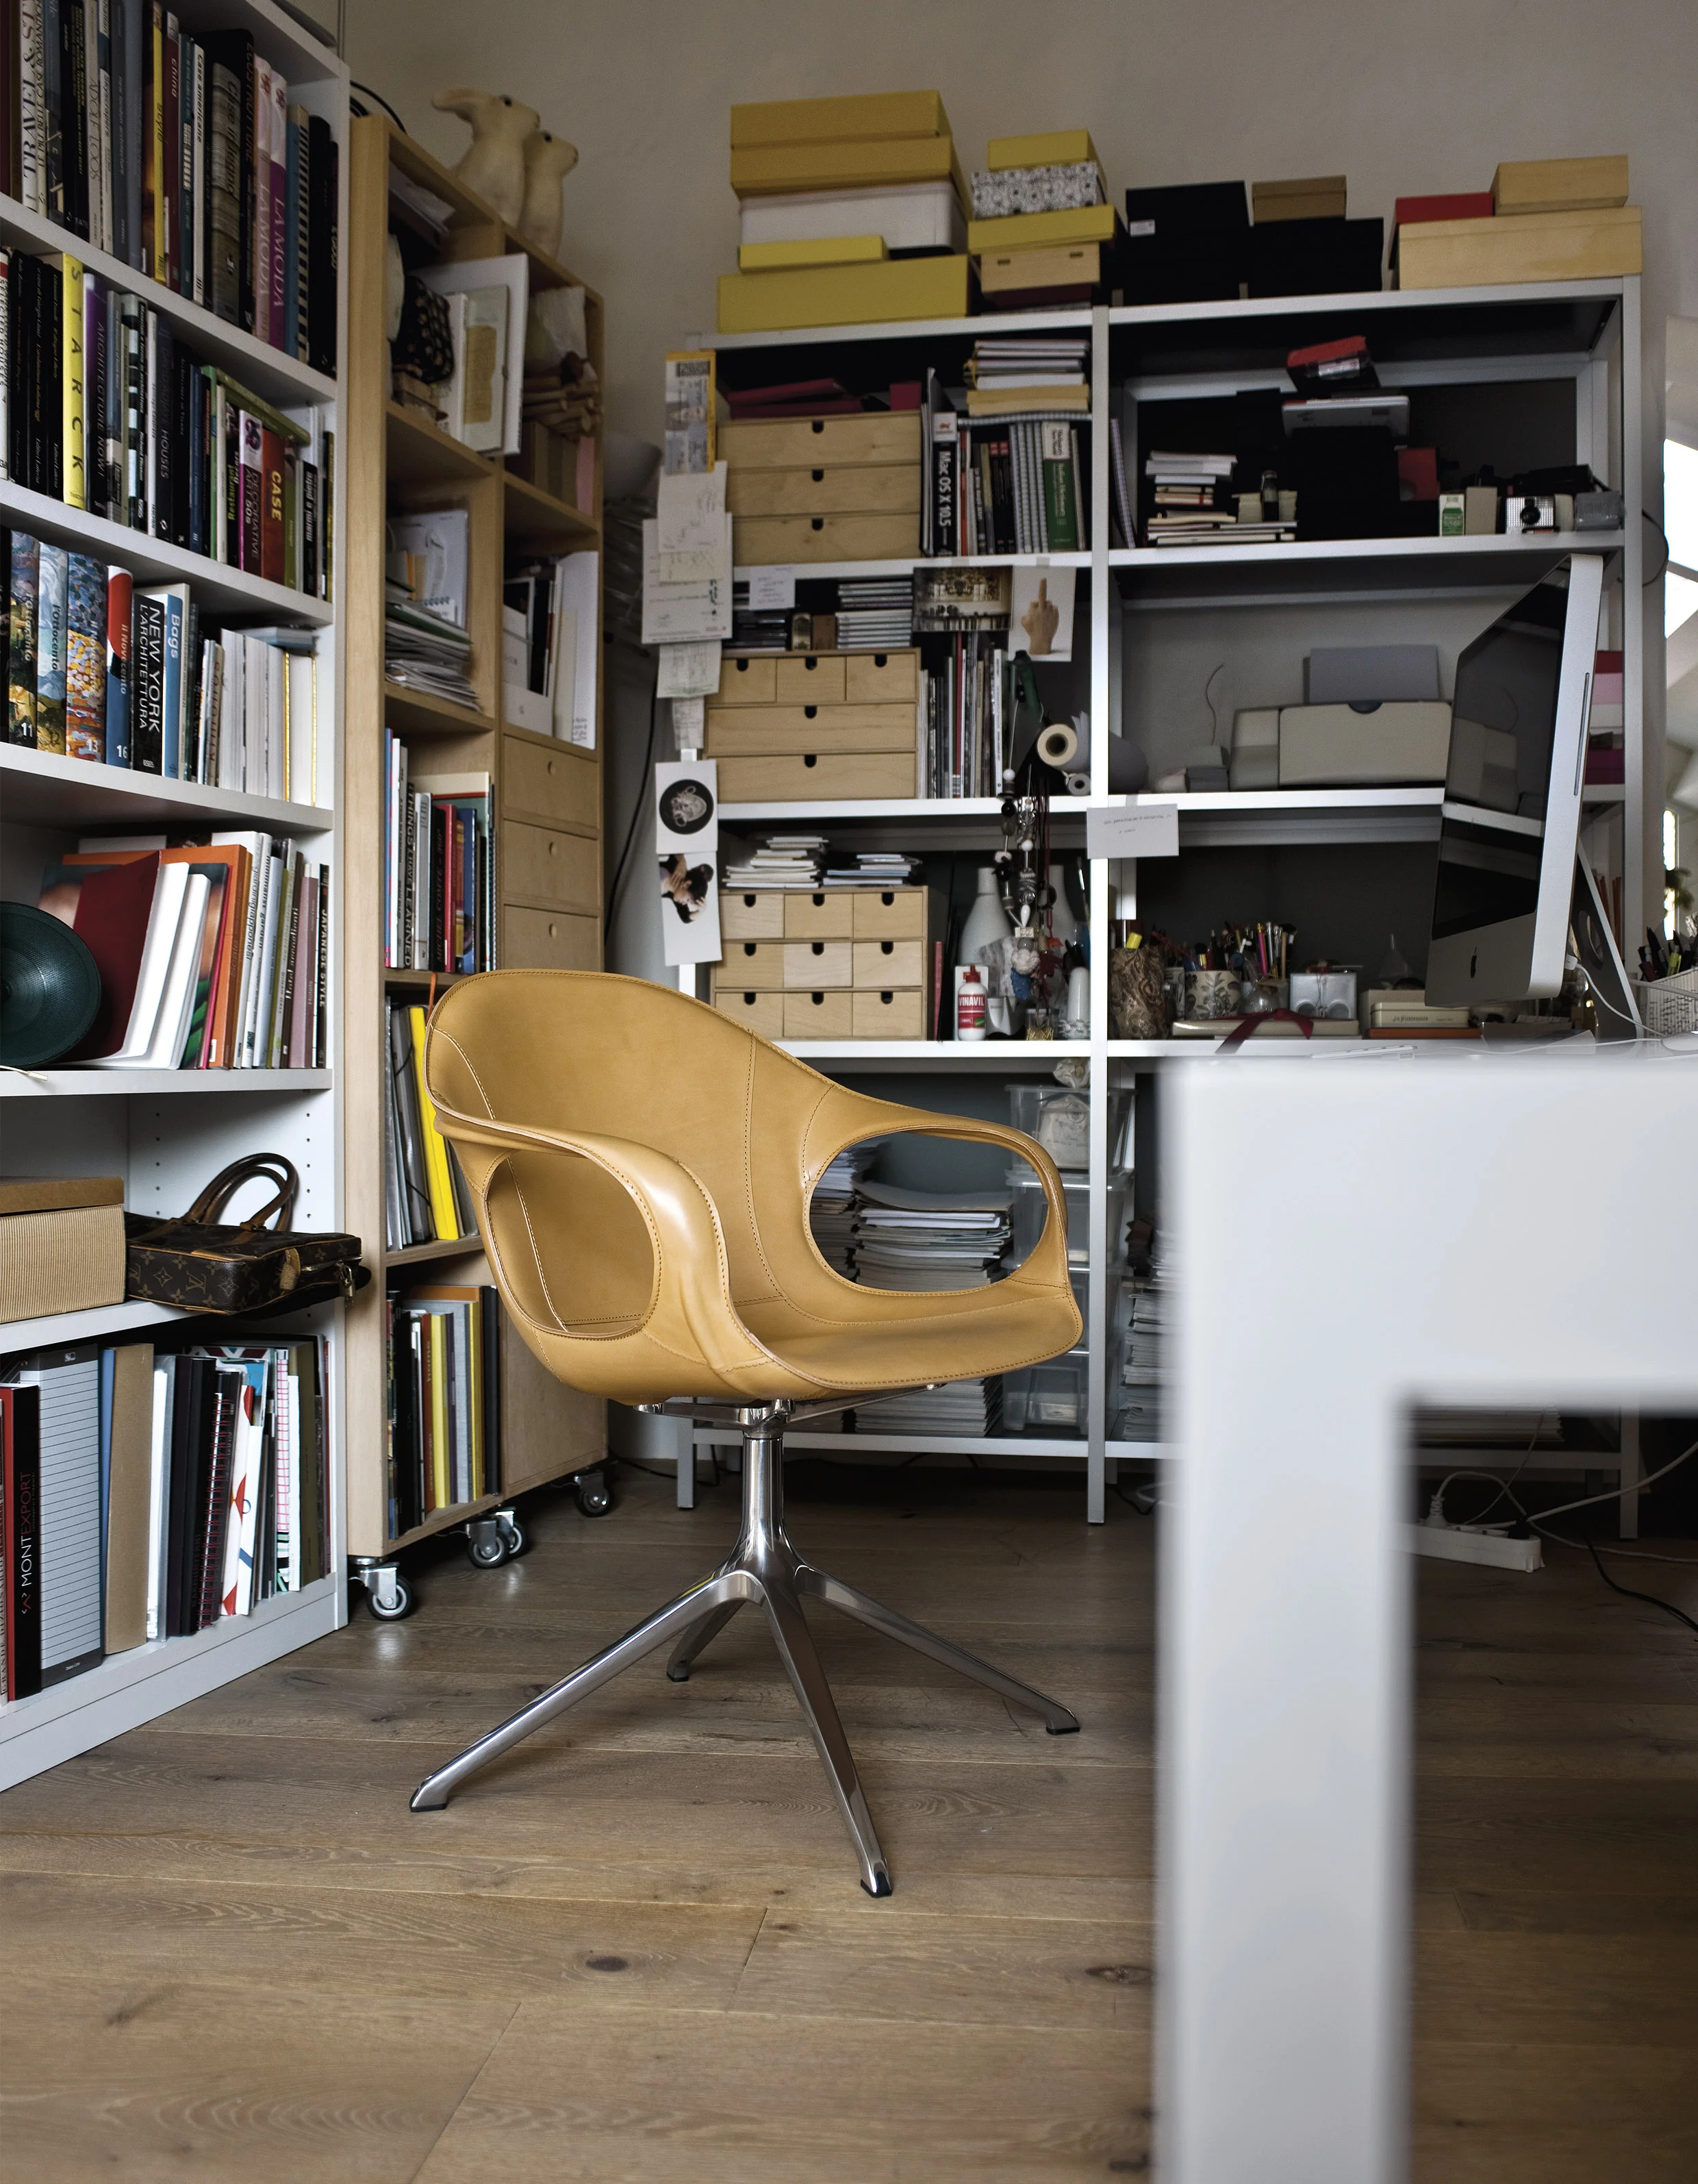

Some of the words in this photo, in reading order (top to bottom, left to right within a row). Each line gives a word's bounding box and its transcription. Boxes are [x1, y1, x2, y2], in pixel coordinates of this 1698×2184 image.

[22, 0, 37, 42] ST
[22, 47, 37, 69] &
[170, 58, 179, 99] china
[22, 70, 37, 179] TRAVEL
[89, 75, 100, 127] ADOLF
[155, 102, 164, 143] style
[227, 81, 238, 124] Case
[245, 42, 254, 164] ECOSTRUTTURE
[89, 136, 101, 181] LOOS
[225, 145, 238, 199] legno
[259, 182, 270, 212] LA
[273, 195, 285, 226] LA
[259, 218, 270, 296] MODA
[273, 230, 285, 307] MODA
[70, 264, 84, 474] STARCK
[96, 321, 105, 432] ARCHITECTURE
[96, 434, 105, 478] NOW!
[159, 428, 170, 480] HOUSES
[937, 451, 953, 477] Mac
[226, 463, 237, 520] Restaurant
[244, 469, 252, 494] ART
[271, 470, 283, 522] CASE
[937, 477, 952, 494] OS
[250, 471, 260, 560] DECORATIVE
[305, 509, 315, 542] marmi
[937, 506, 952, 529] 10.5
[23, 592, 34, 663] l'Ottocento
[50, 603, 62, 672] l'Ottocento
[147, 606, 162, 664] NEW
[167, 612, 181, 659] Bags
[118, 632, 129, 695] Novecento
[138, 603, 150, 731] L'ARCHITETTURA
[146, 670, 162, 734] YORK
[21, 721, 34, 738] 11
[406, 791, 416, 846] THINGS
[262, 854, 271, 909] minimalist
[406, 854, 414, 883] HAVE
[257, 912, 267, 949] garden
[319, 908, 329, 970] JAPANESE
[404, 886, 414, 966] LEARNED
[278, 971, 286, 996] DINAH
[318, 971, 327, 1008] STYLE
[959, 996, 985, 1007] VINAVIL
[20, 1470, 33, 1587] MONTEXPORT
